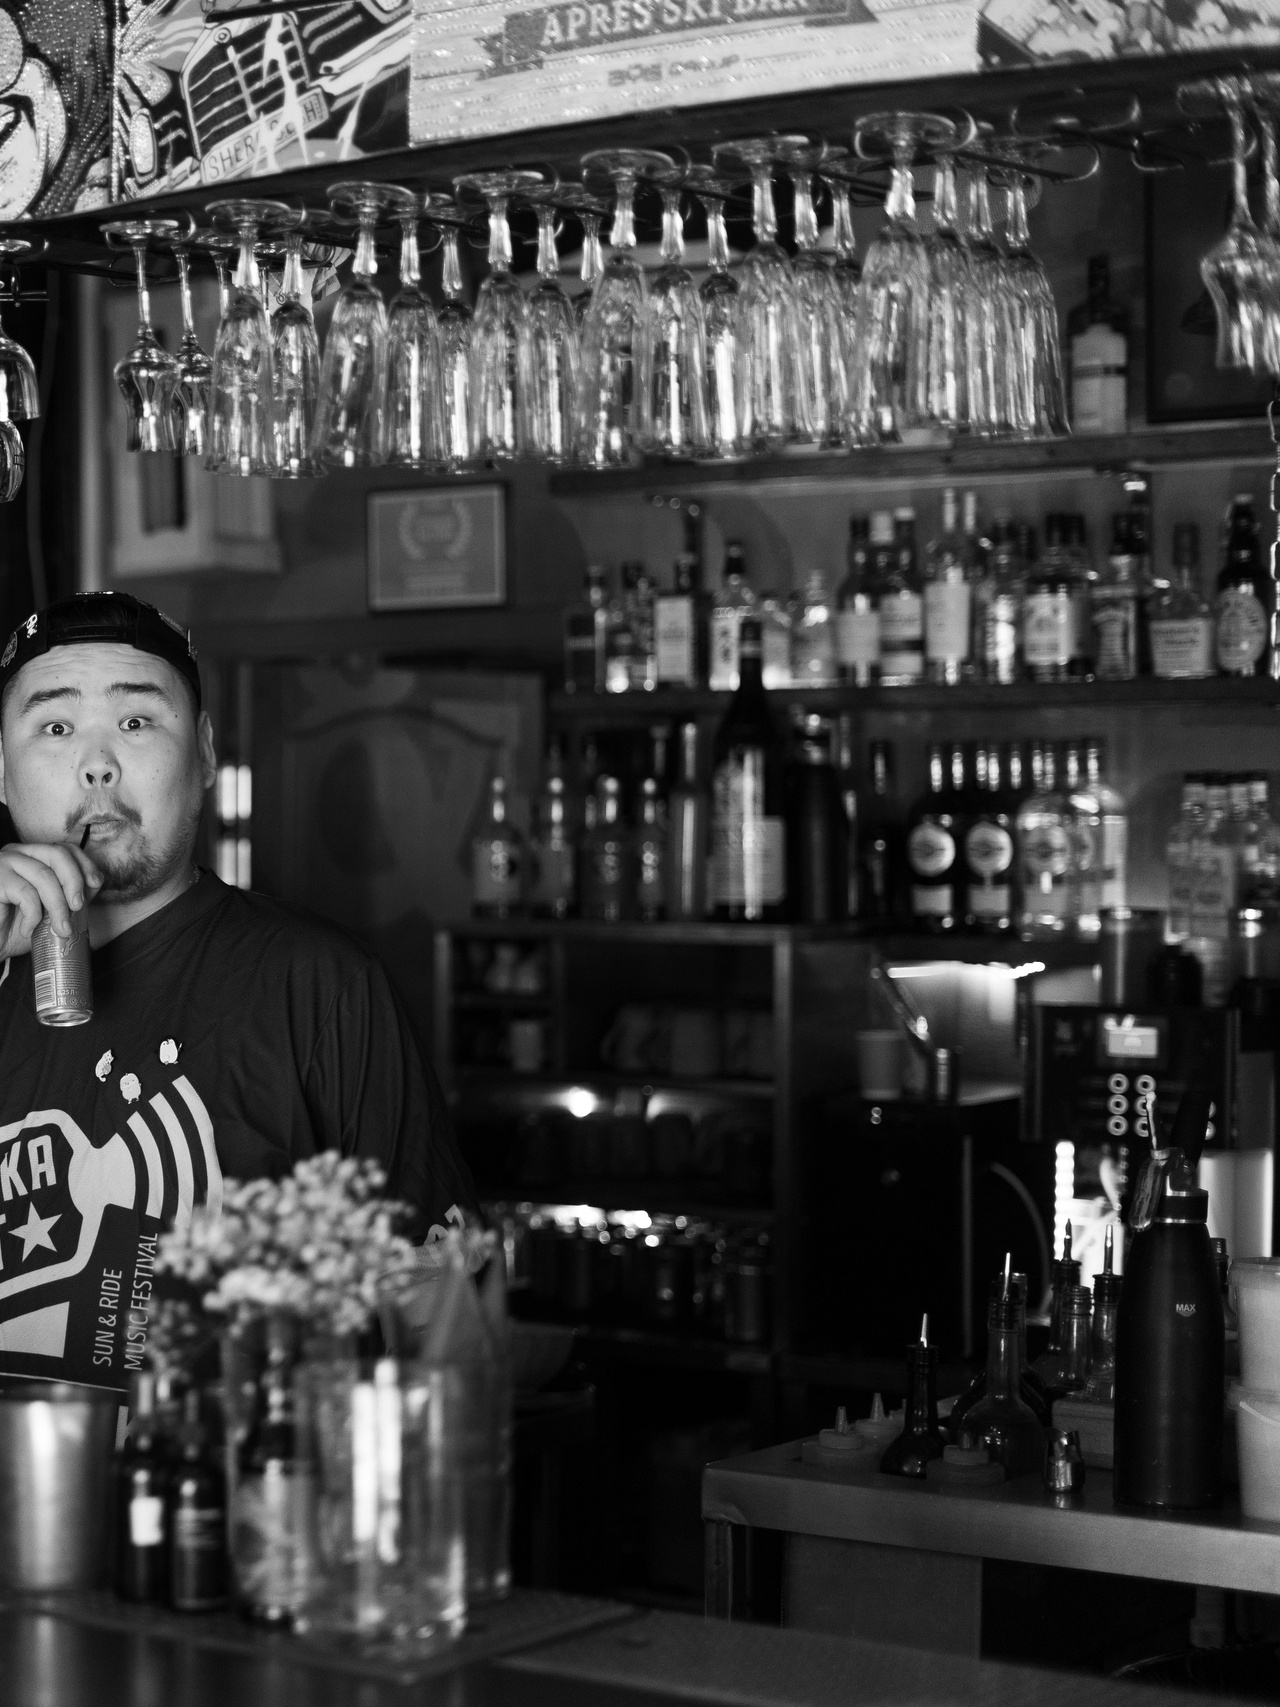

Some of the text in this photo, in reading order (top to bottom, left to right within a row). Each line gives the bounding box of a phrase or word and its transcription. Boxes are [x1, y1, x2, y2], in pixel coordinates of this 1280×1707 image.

[92, 1267, 123, 1367] SUN & RIDE
[123, 1232, 158, 1371] MUSIC FESTIVAL
[1175, 1303, 1197, 1312] MAX
